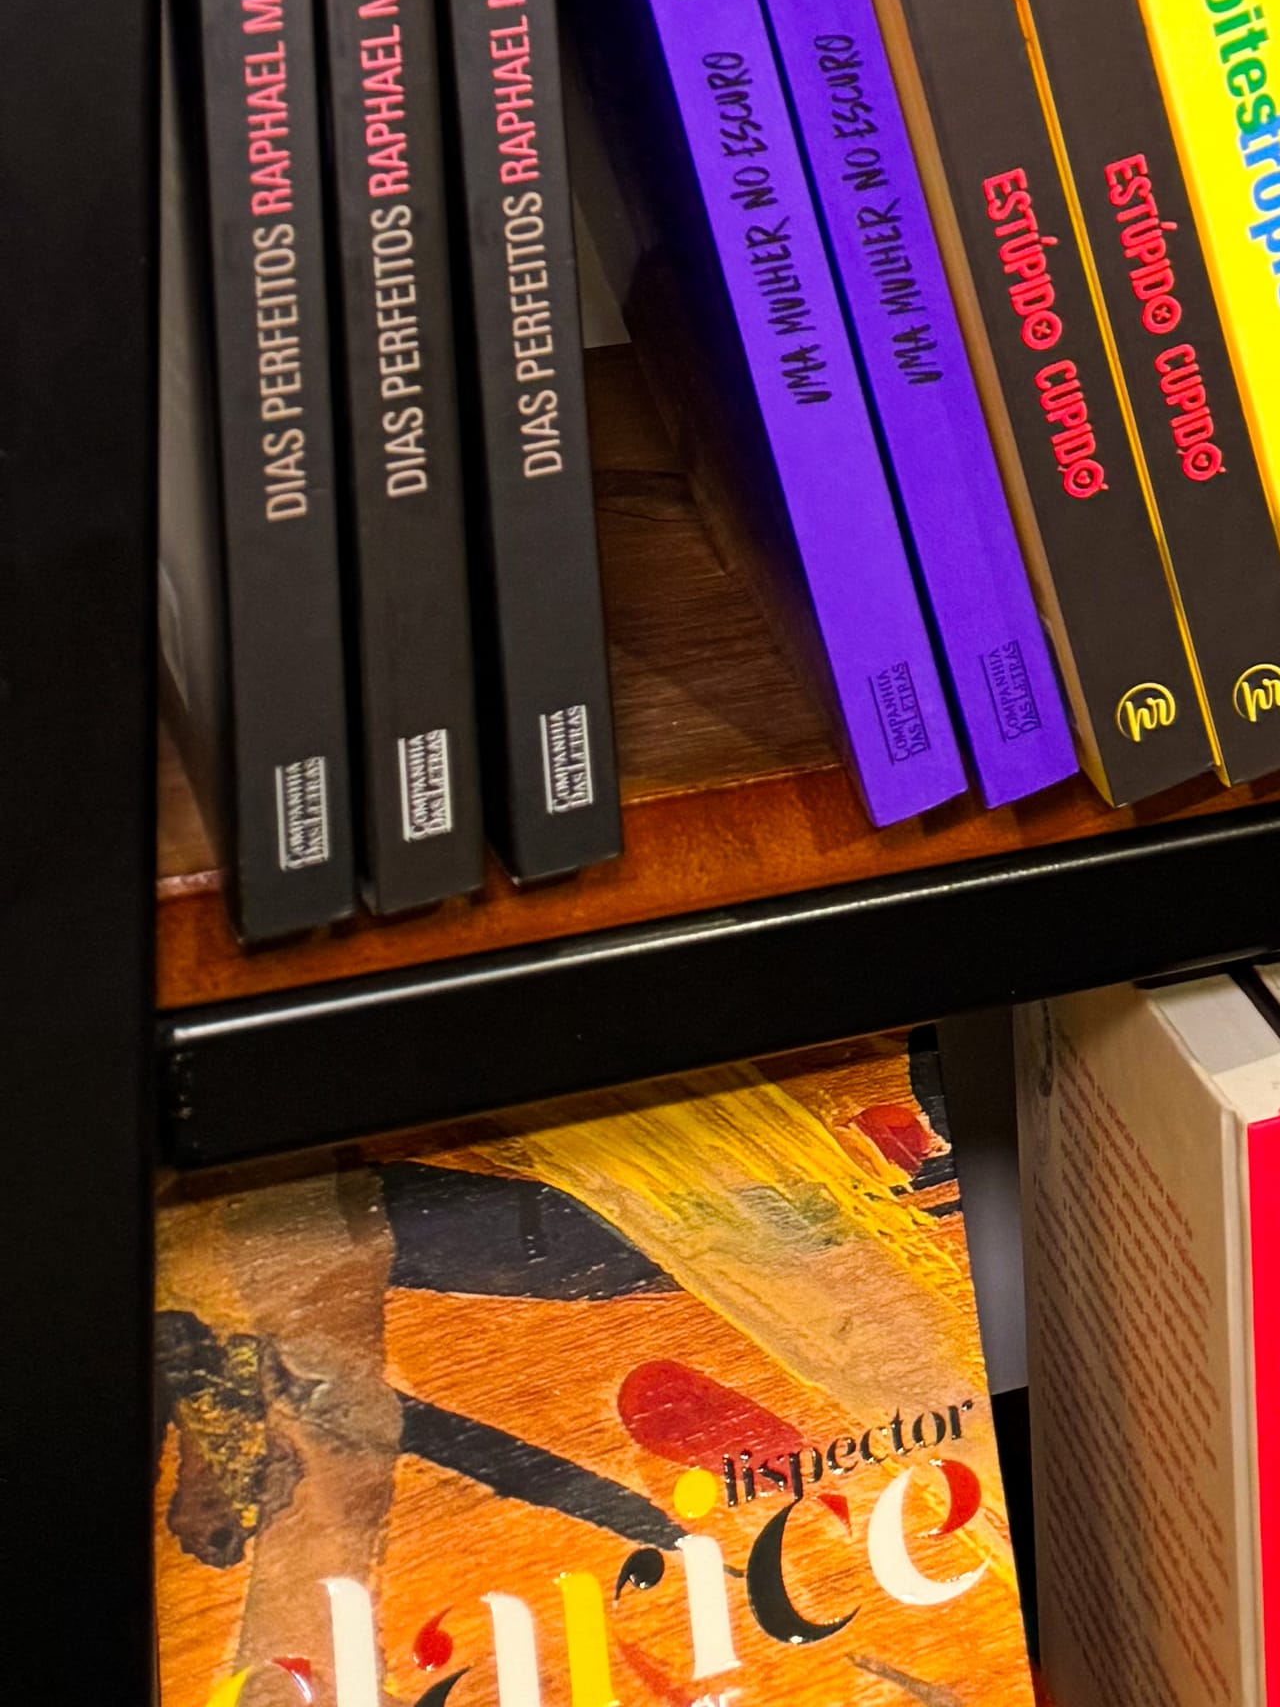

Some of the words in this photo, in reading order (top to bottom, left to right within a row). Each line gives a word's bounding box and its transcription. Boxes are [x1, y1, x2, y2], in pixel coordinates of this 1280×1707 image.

[245, 41, 291, 214] RAPHAEL
[702, 52, 767, 157] ESCURO
[730, 166, 777, 210] NO
[253, 223, 302, 419] PERFEITOS
[744, 218, 813, 335] MULHER
[982, 167, 1062, 350] ESTÚPIDO
[1034, 359, 1108, 498] CUPIDO
[779, 345, 832, 404] UMA
[263, 428, 306, 519] DIAS
[722, 1397, 975, 1509] lispector
